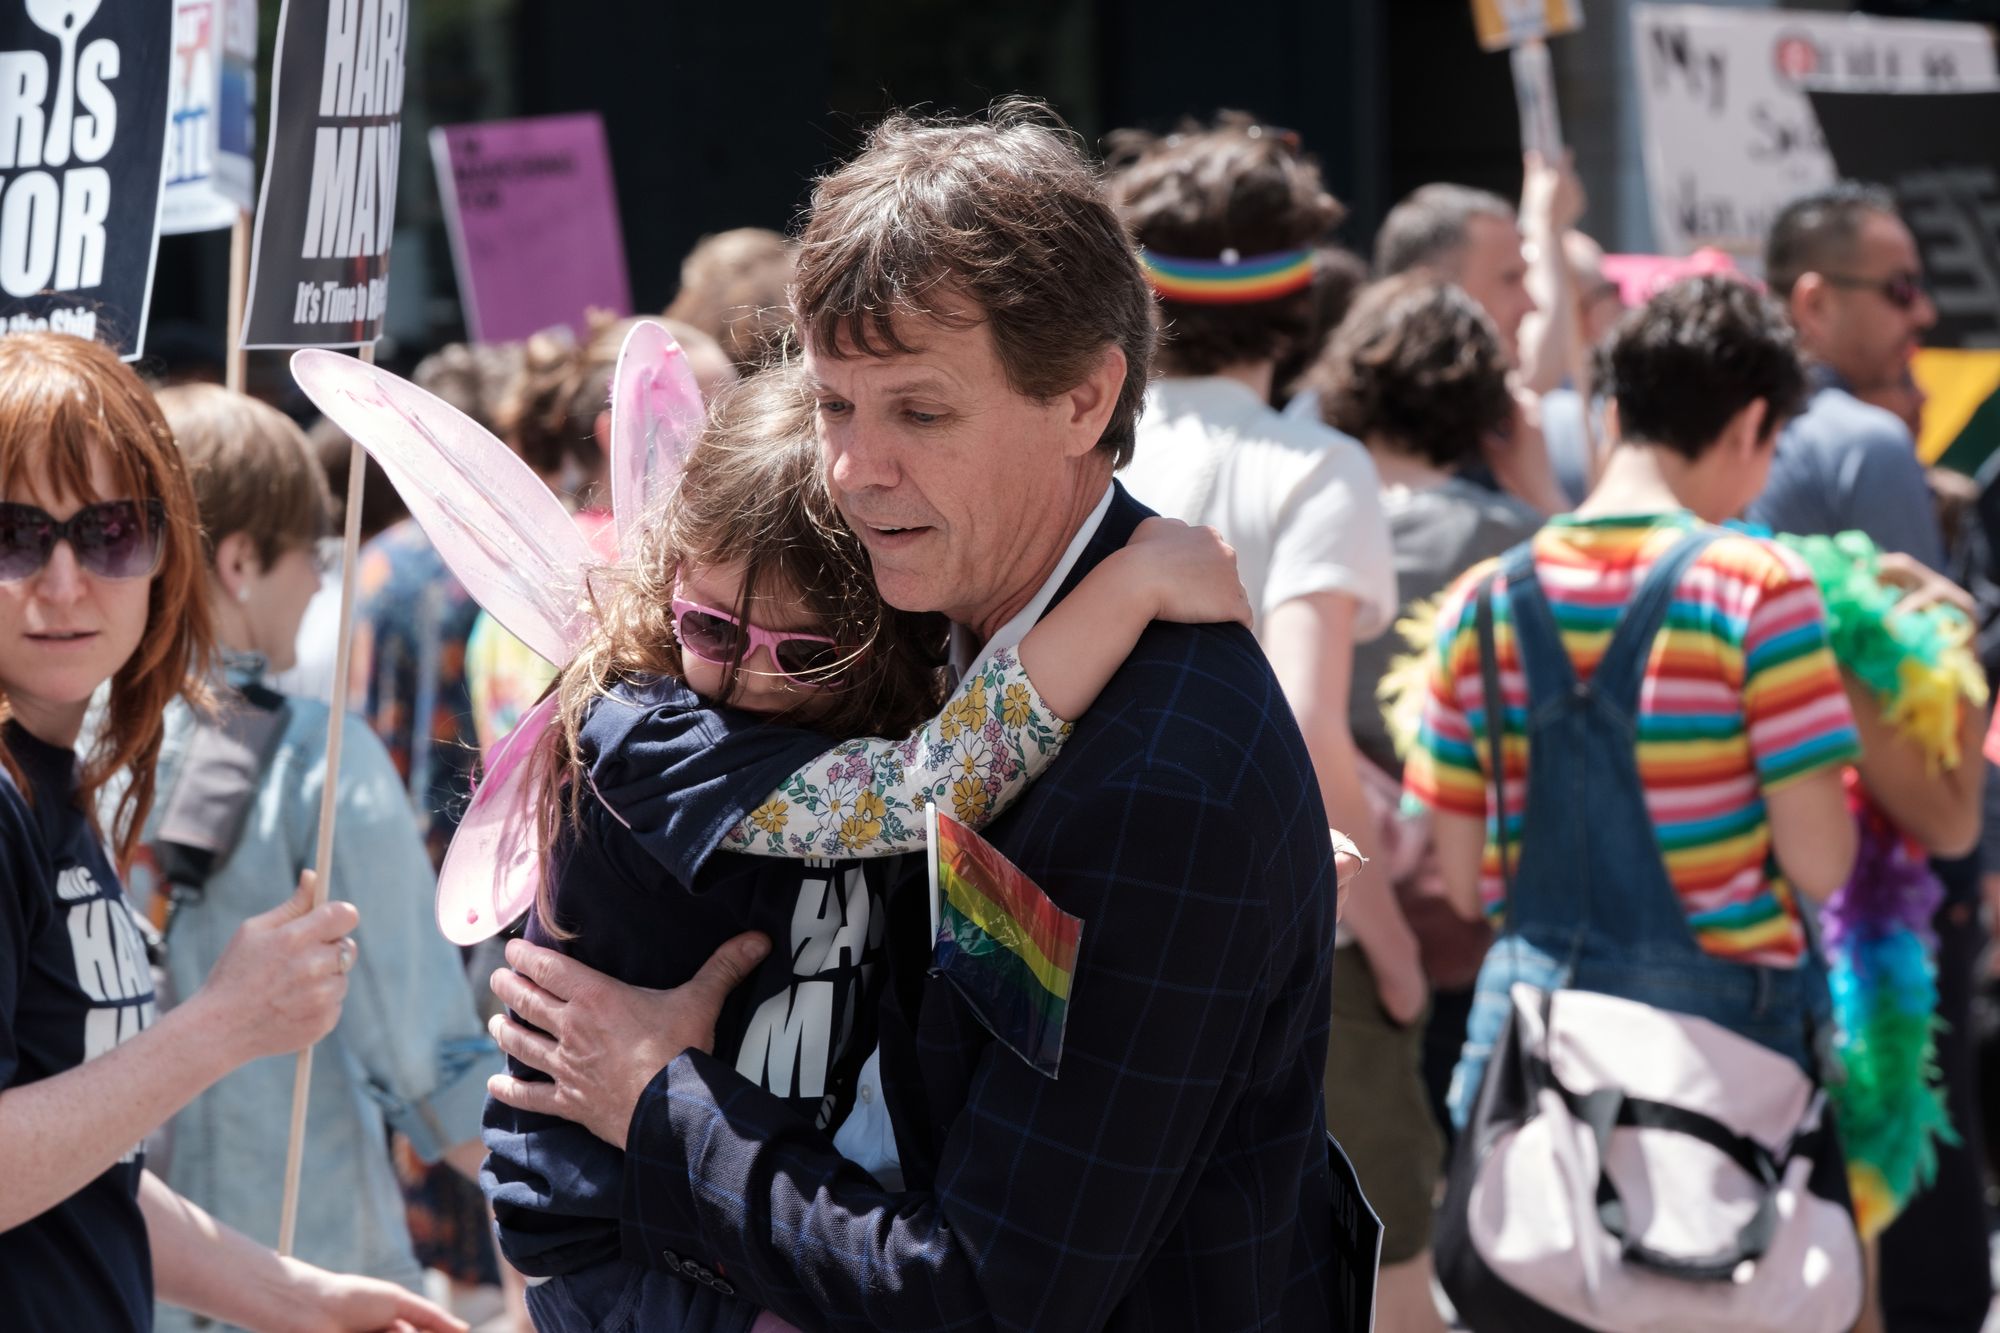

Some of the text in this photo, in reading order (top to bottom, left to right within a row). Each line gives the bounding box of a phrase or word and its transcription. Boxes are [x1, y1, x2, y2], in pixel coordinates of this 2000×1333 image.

[319, 0, 408, 117] HAR
[0, 166, 111, 298] OR
[293, 281, 321, 324] It's
